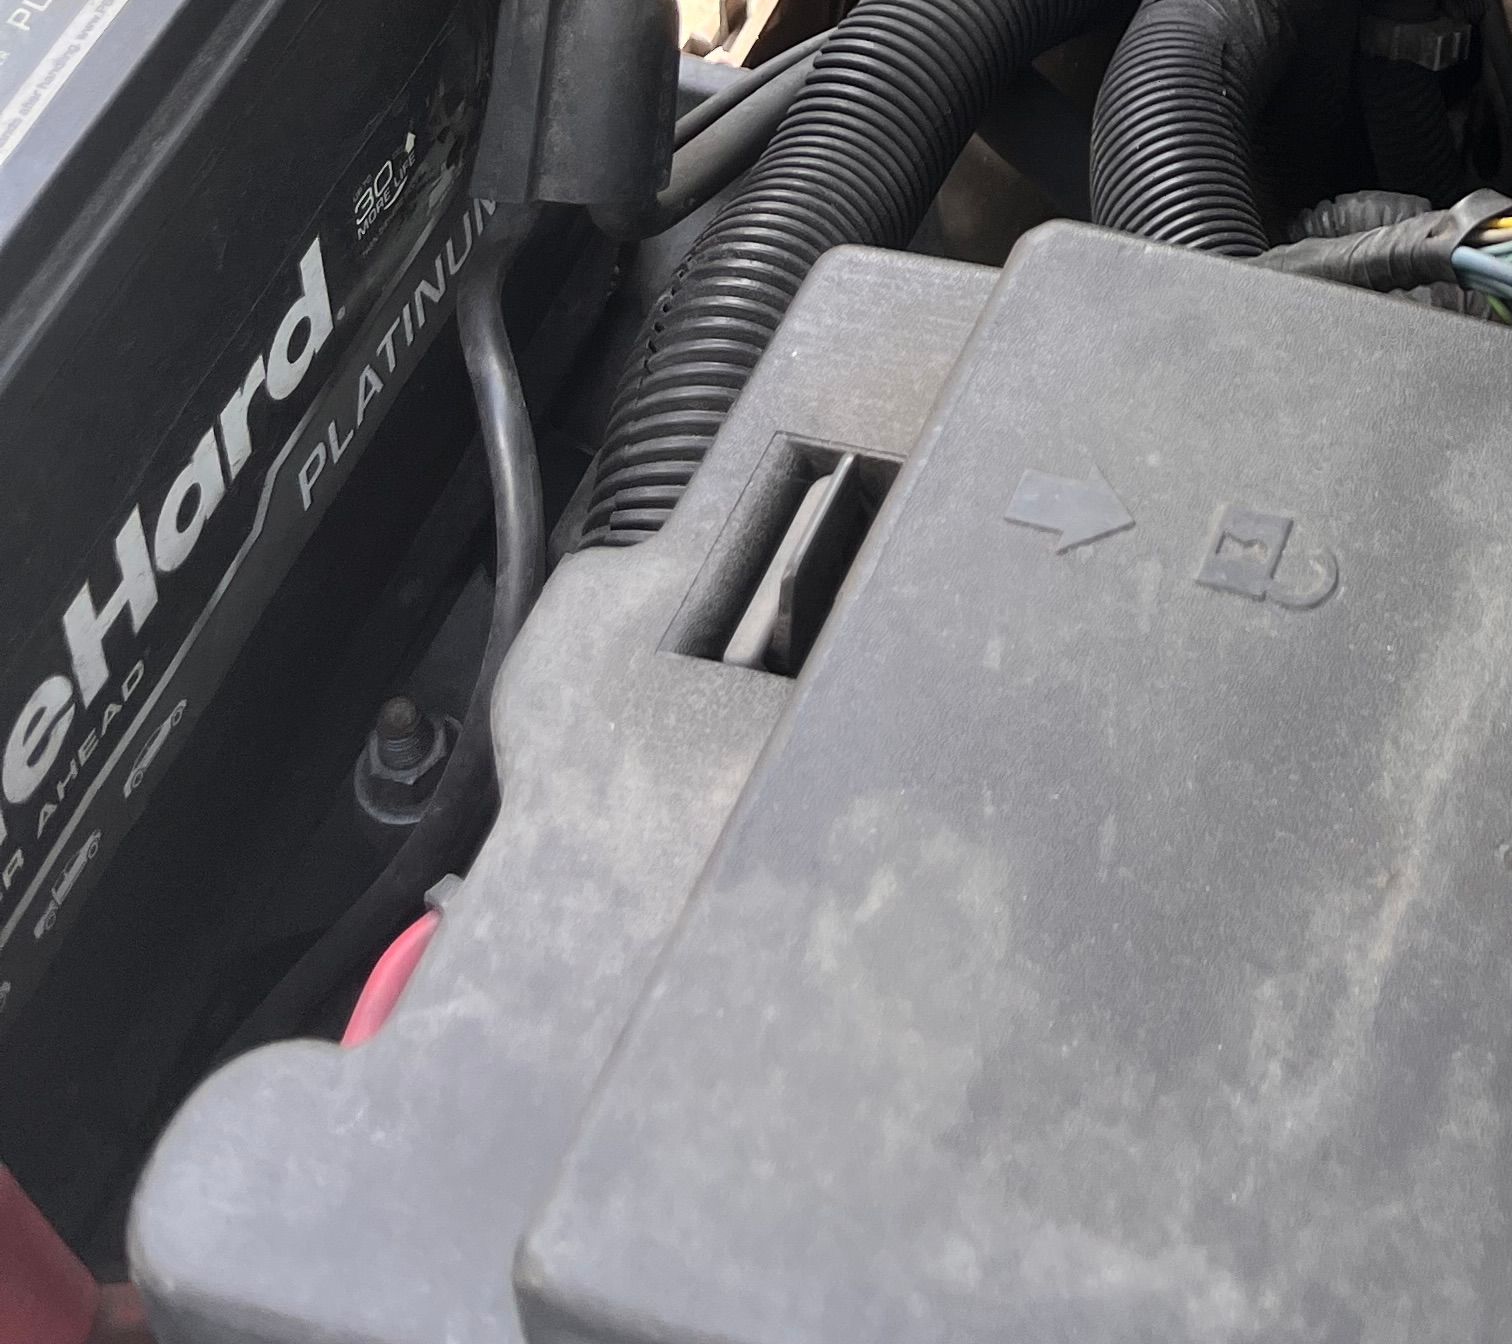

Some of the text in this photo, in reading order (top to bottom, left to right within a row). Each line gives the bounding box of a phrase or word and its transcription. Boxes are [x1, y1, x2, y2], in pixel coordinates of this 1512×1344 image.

[356, 186, 392, 241] MORE
[393, 150, 417, 188] LIFE
[37, 659, 145, 840] AHEAD
